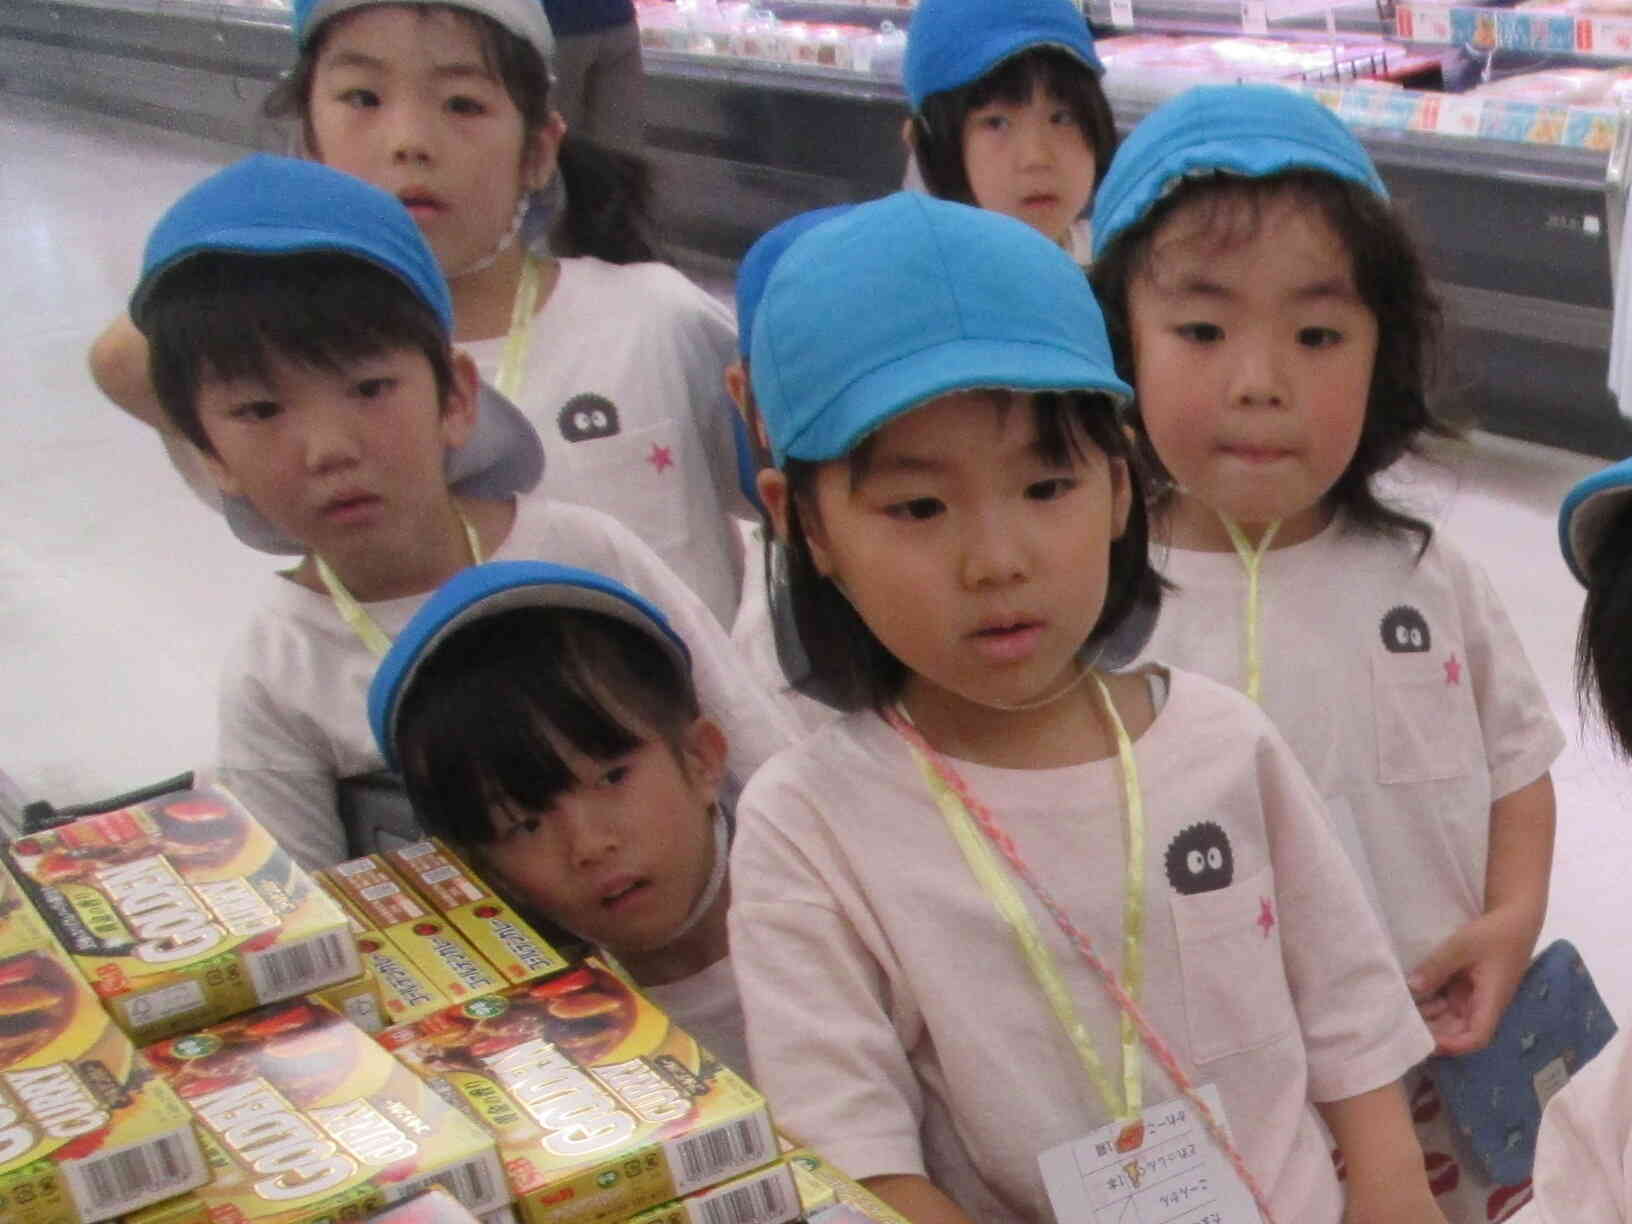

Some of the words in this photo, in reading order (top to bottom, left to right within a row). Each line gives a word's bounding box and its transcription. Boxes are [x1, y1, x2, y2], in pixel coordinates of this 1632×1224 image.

[304, 1097, 419, 1166] CURRY
[483, 1038, 636, 1157] GOLDEN
[592, 1057, 694, 1123] CURRY
[188, 1076, 358, 1201] GOLDEN
